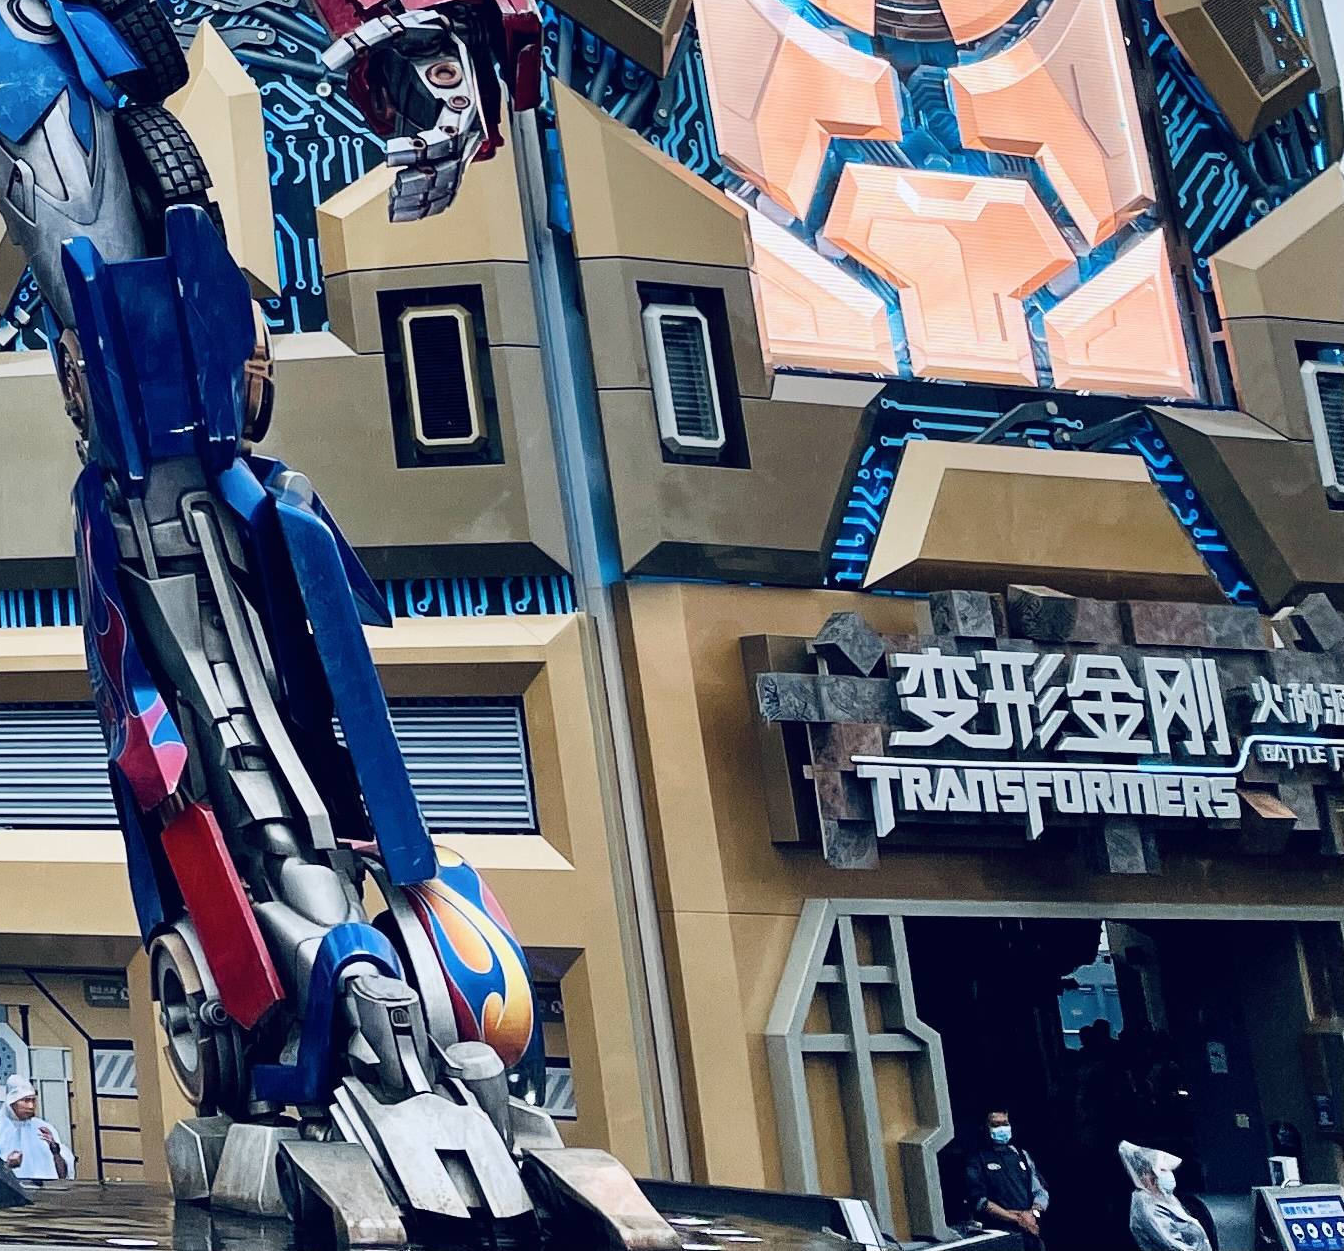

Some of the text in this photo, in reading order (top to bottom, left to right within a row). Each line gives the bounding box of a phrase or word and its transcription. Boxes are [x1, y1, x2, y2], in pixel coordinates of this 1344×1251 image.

[889, 647, 1233, 756] 变形金刚
[1257, 744, 1328, 770] BATTLE
[856, 764, 1242, 841] TRANSFORMERS
